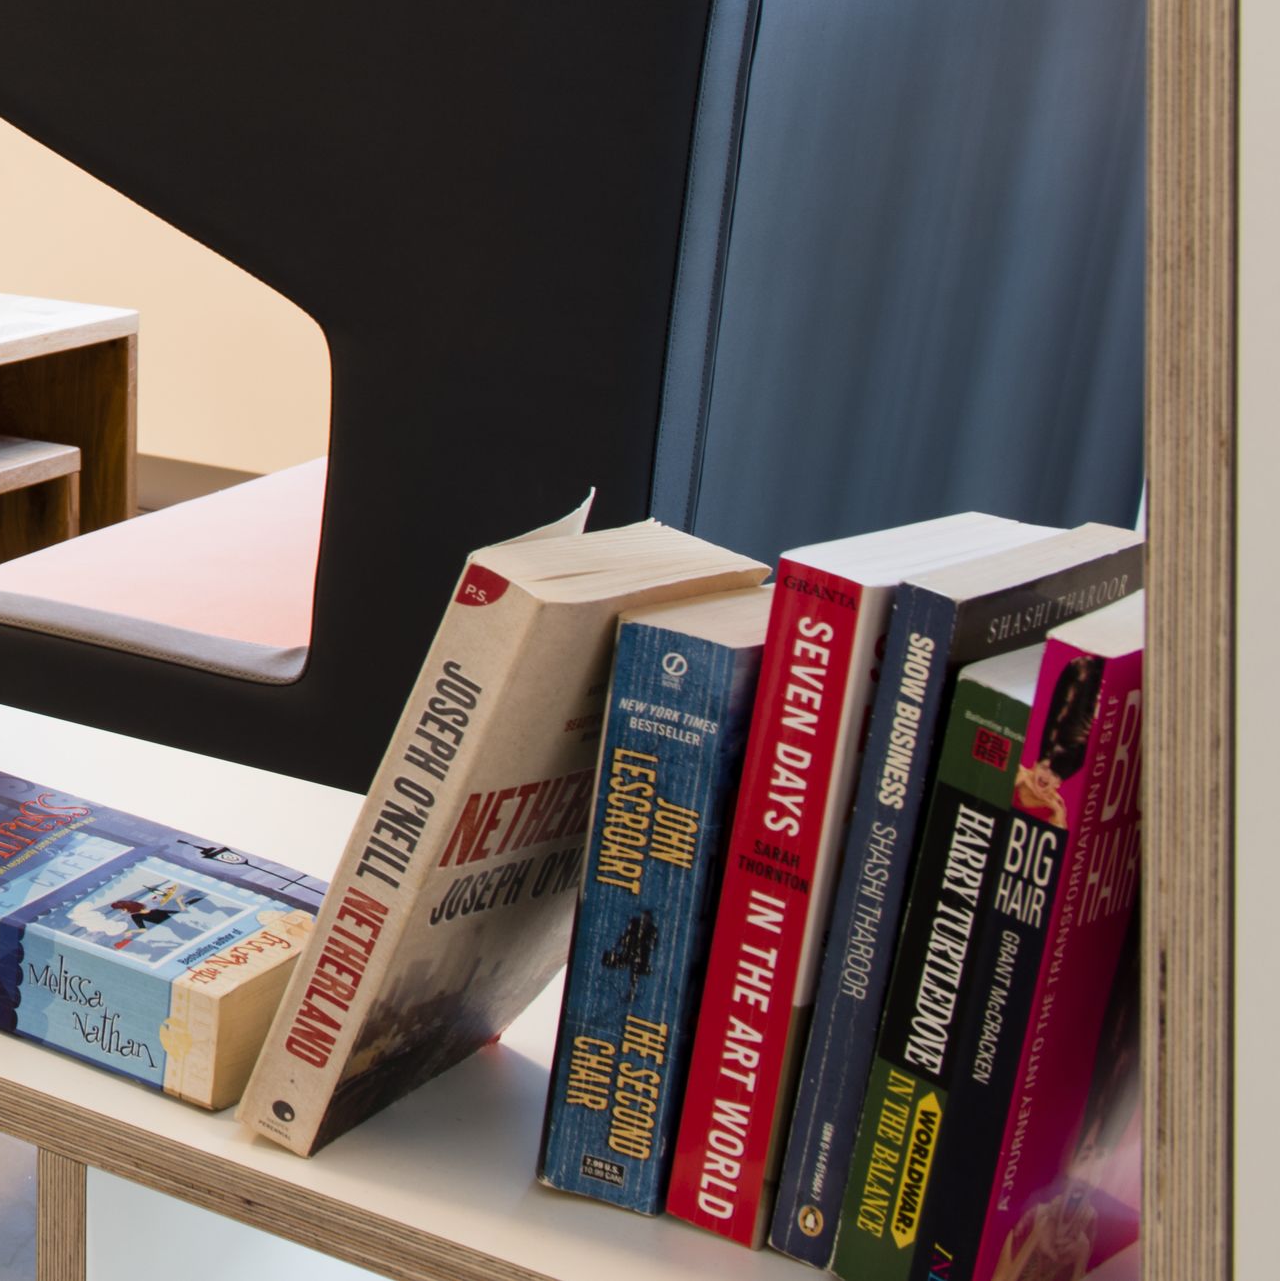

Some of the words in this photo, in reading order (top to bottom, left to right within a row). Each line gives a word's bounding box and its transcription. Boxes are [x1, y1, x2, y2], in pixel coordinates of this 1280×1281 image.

[784, 575, 857, 611] GRANTA
[781, 616, 835, 735] SEVEN
[899, 632, 935, 704] SHOW
[403, 660, 483, 783] JOSEPH
[619, 698, 647, 713] NEW
[649, 704, 681, 723] YORK
[683, 713, 719, 735] TIMES
[629, 716, 701, 746] BESTSELLER
[763, 741, 812, 838] DAYS
[878, 701, 922, 811] BUSINESS
[355, 776, 435, 889] O'NEILL
[595, 747, 660, 896] LESCROART
[649, 797, 699, 870] JOHN
[940, 803, 995, 902] HARRY
[1003, 817, 1058, 887] BIG
[738, 854, 810, 896] THORNTON
[745, 889, 786, 935] IN
[994, 875, 1046, 929] HAIR
[28, 954, 104, 1009] Melissa
[285, 886, 390, 1069] NETHERLAND
[732, 942, 778, 1013] THE
[904, 899, 976, 1076] TURTLEDOVE
[994, 929, 1020, 988] GRANT
[73, 1007, 158, 1069] Nathan
[621, 1013, 668, 1065] THE
[719, 1015, 765, 1093] ART
[972, 985, 1007, 1085] McCRACKEN
[566, 1034, 616, 1112] CHAIR
[608, 1060, 662, 1162] SECOND
[697, 1097, 751, 1222] WORLD
